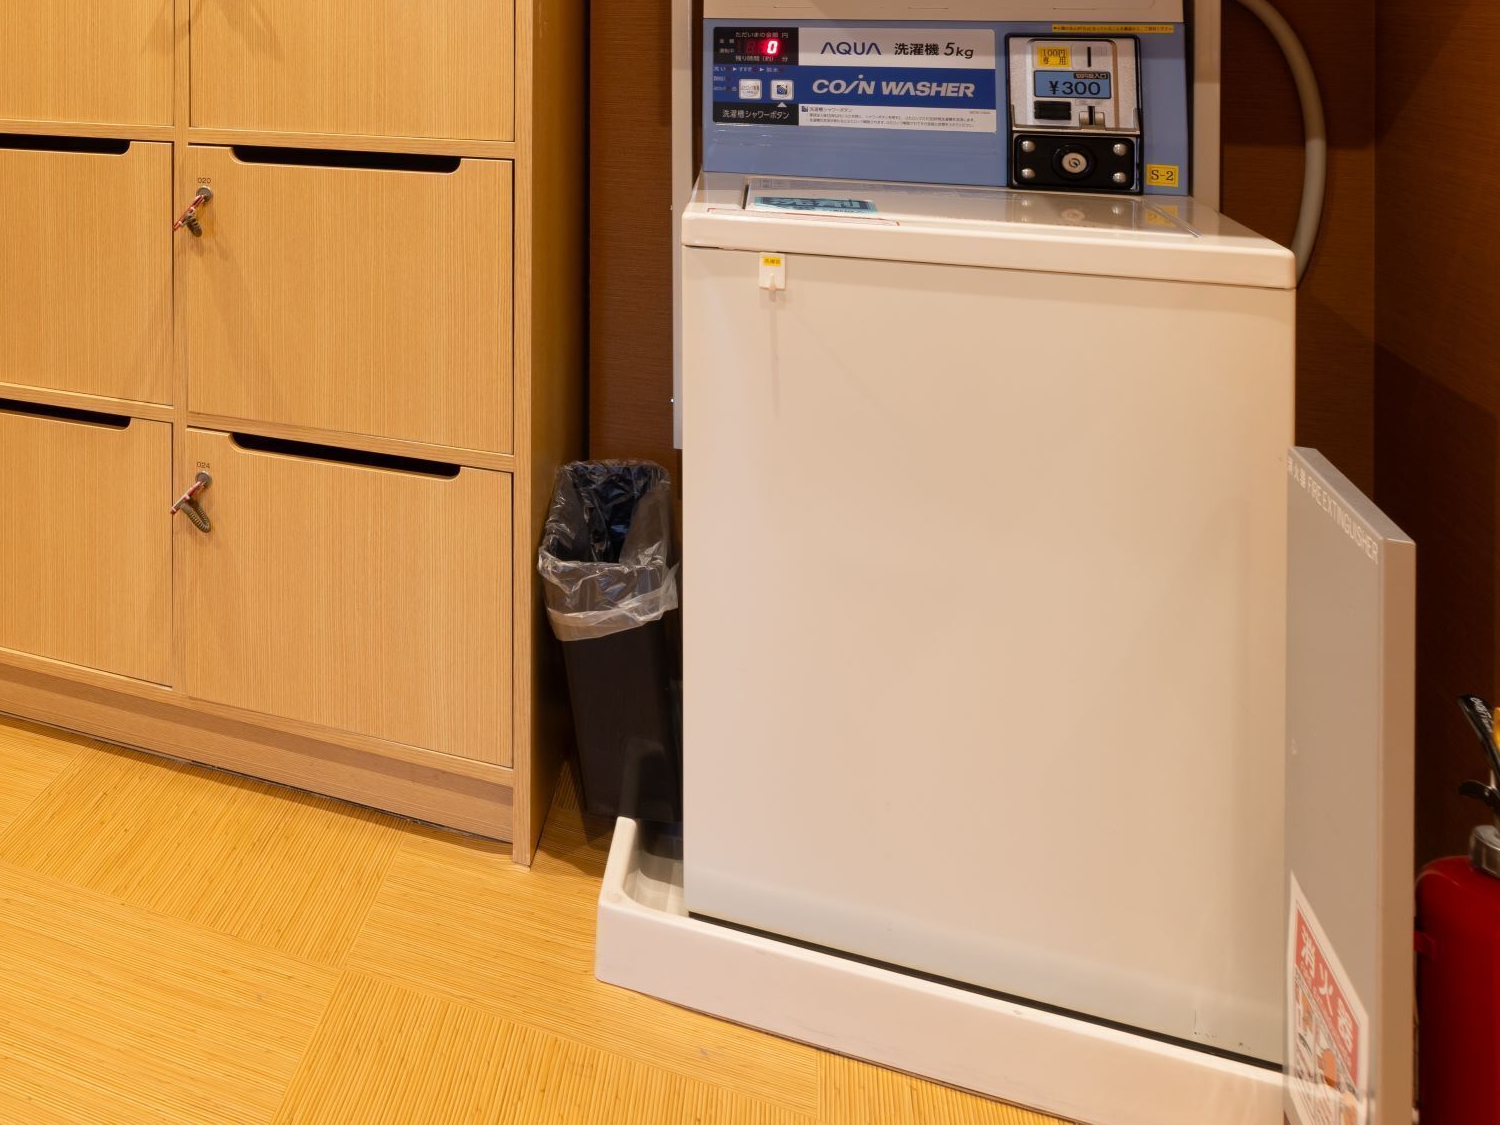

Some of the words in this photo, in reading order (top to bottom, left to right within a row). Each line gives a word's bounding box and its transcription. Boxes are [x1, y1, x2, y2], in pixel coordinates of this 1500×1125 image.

[767, 40, 778, 54] 0
[820, 42, 882, 55] AQUA
[894, 42, 940, 56] 洗濯機
[943, 42, 974, 59] 5kg
[1043, 49, 1066, 58] 100円
[812, 74, 876, 94] COIN
[881, 81, 976, 98] WASHER
[1049, 81, 1100, 96] ¥300
[722, 109, 790, 120] 洗濯槽シャワーボタン
[1151, 170, 1174, 181] S-2
[196, 461, 210, 469] 024
[1307, 476, 1322, 506] FIRE
[1322, 491, 1378, 564] EXTINGUISHER
